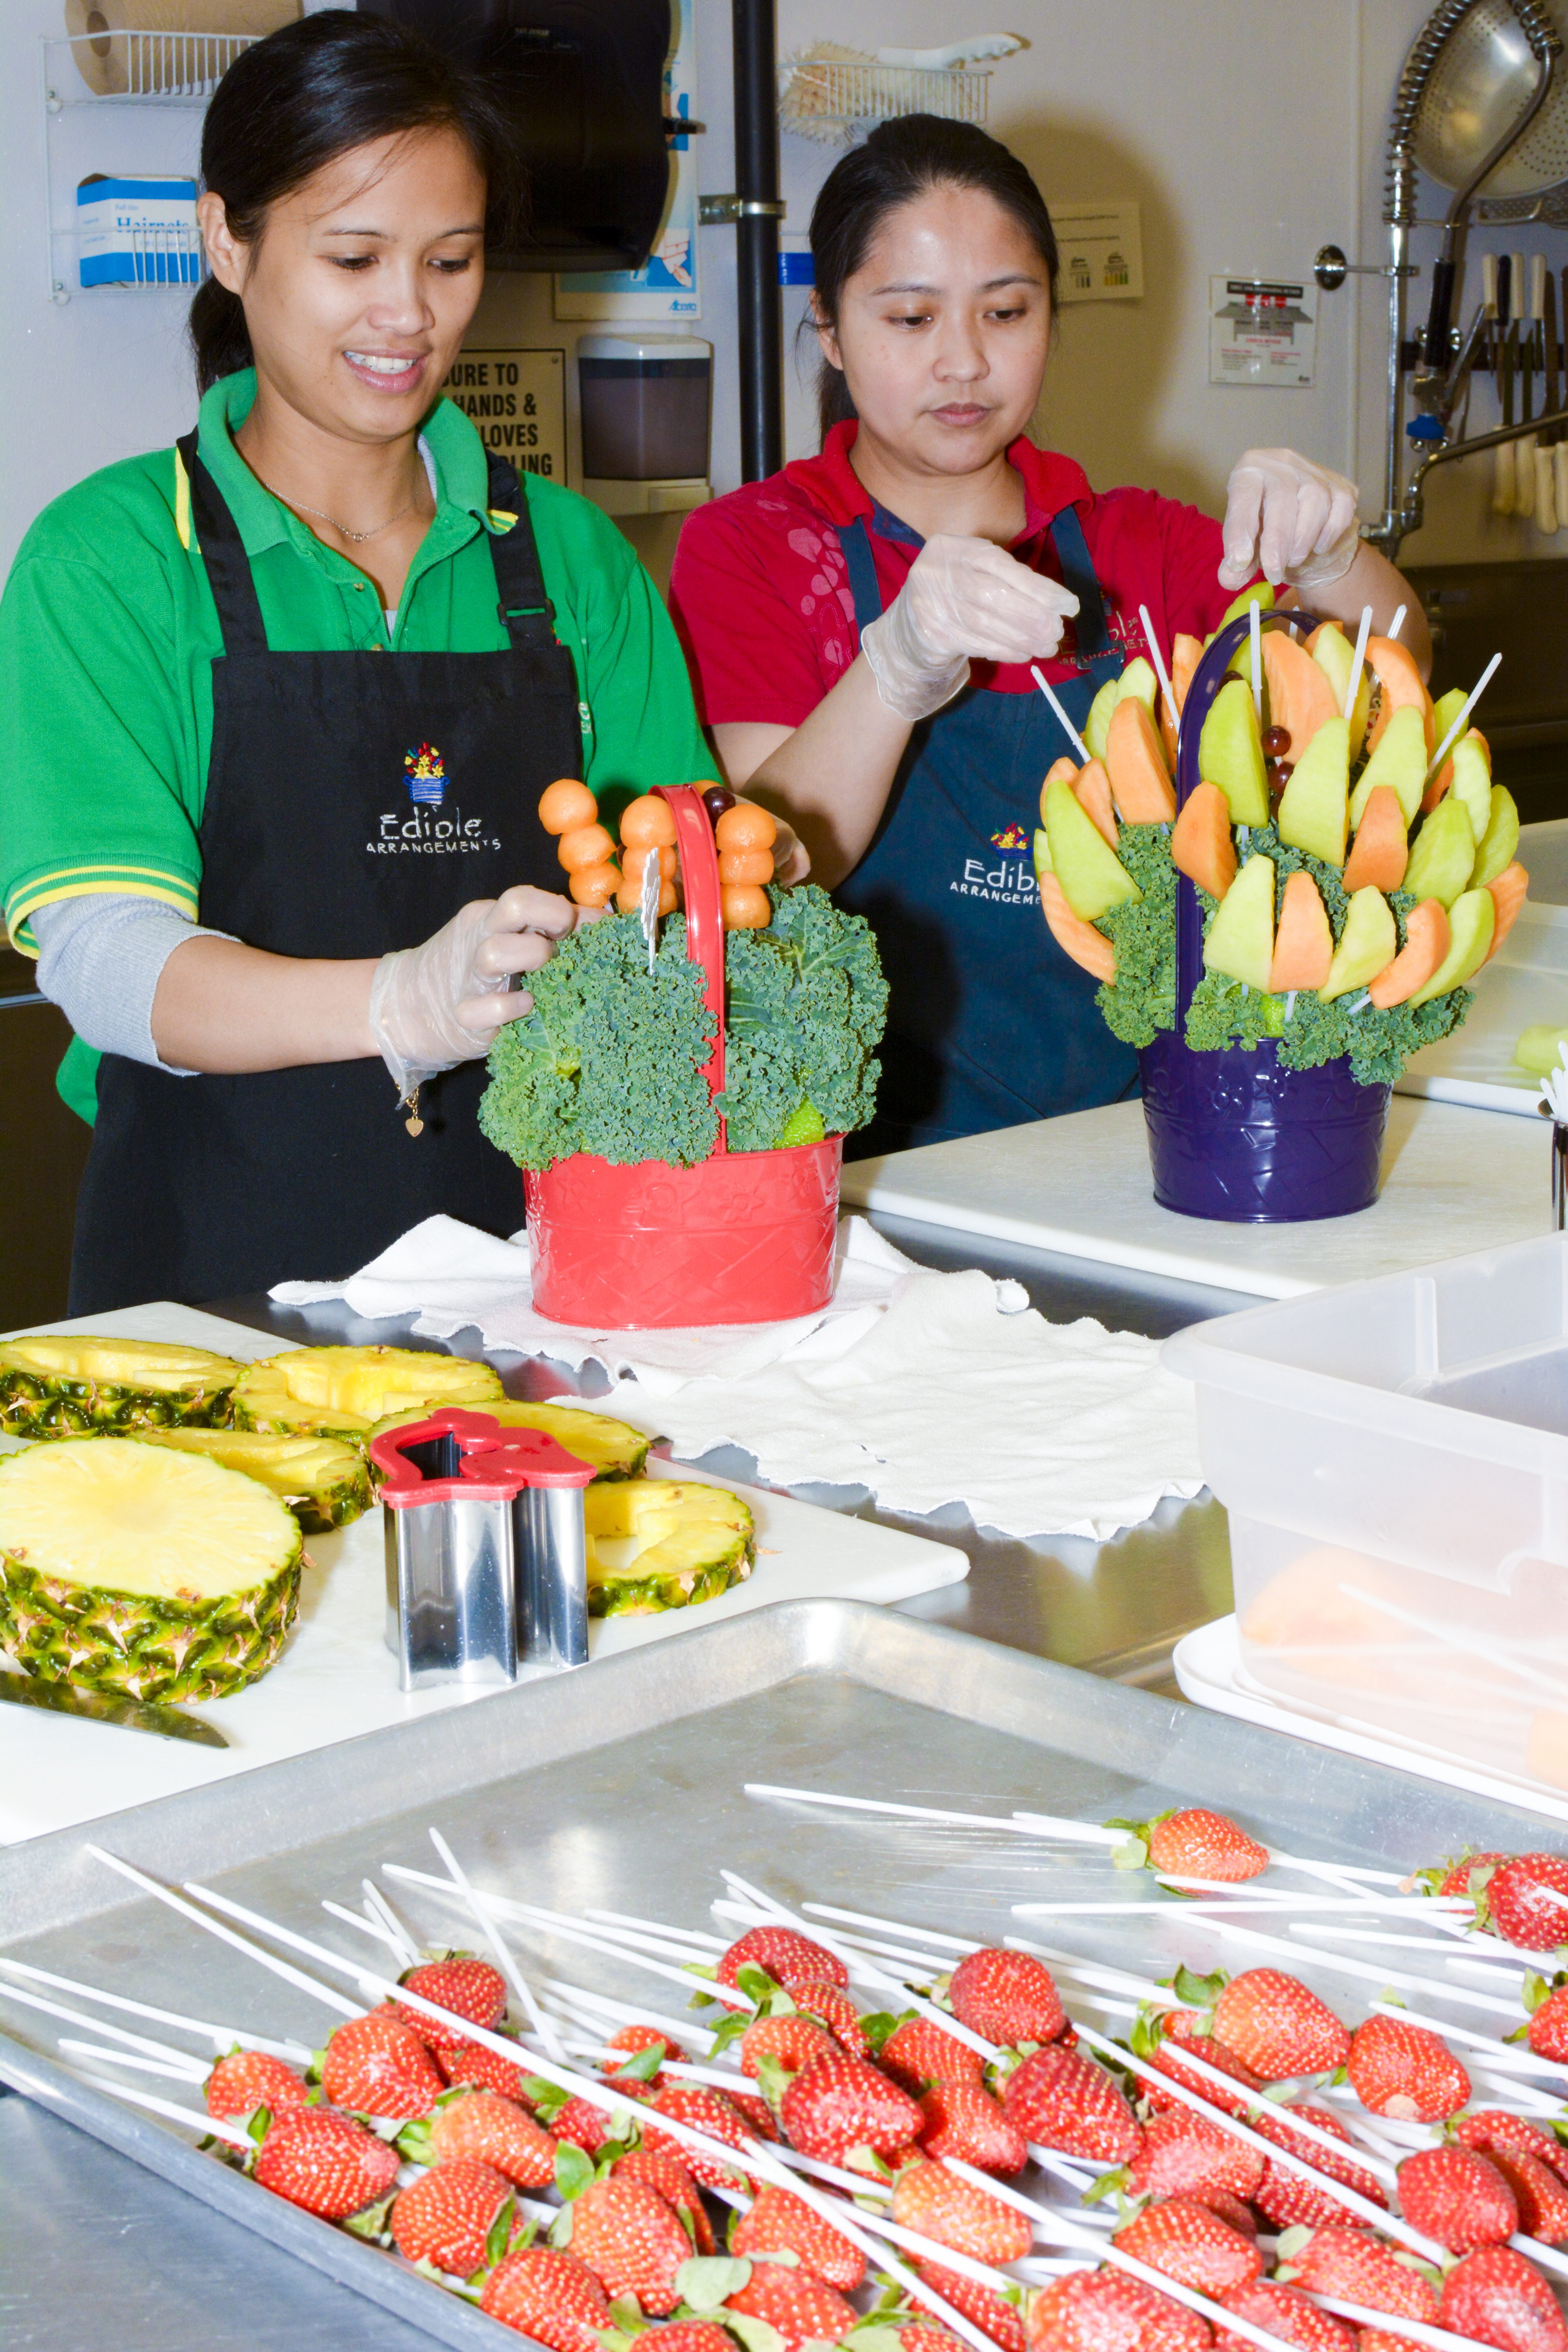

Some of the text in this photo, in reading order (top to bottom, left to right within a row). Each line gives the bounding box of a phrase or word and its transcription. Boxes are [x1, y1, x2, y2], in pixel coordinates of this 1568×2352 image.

[116, 217, 188, 234] Hairnets
[494, 362, 519, 386] TO
[523, 392, 537, 416] &
[480, 423, 538, 448] LOVES
[964, 859, 1040, 891] Edib
[950, 881, 1041, 905] ARRANGEME
